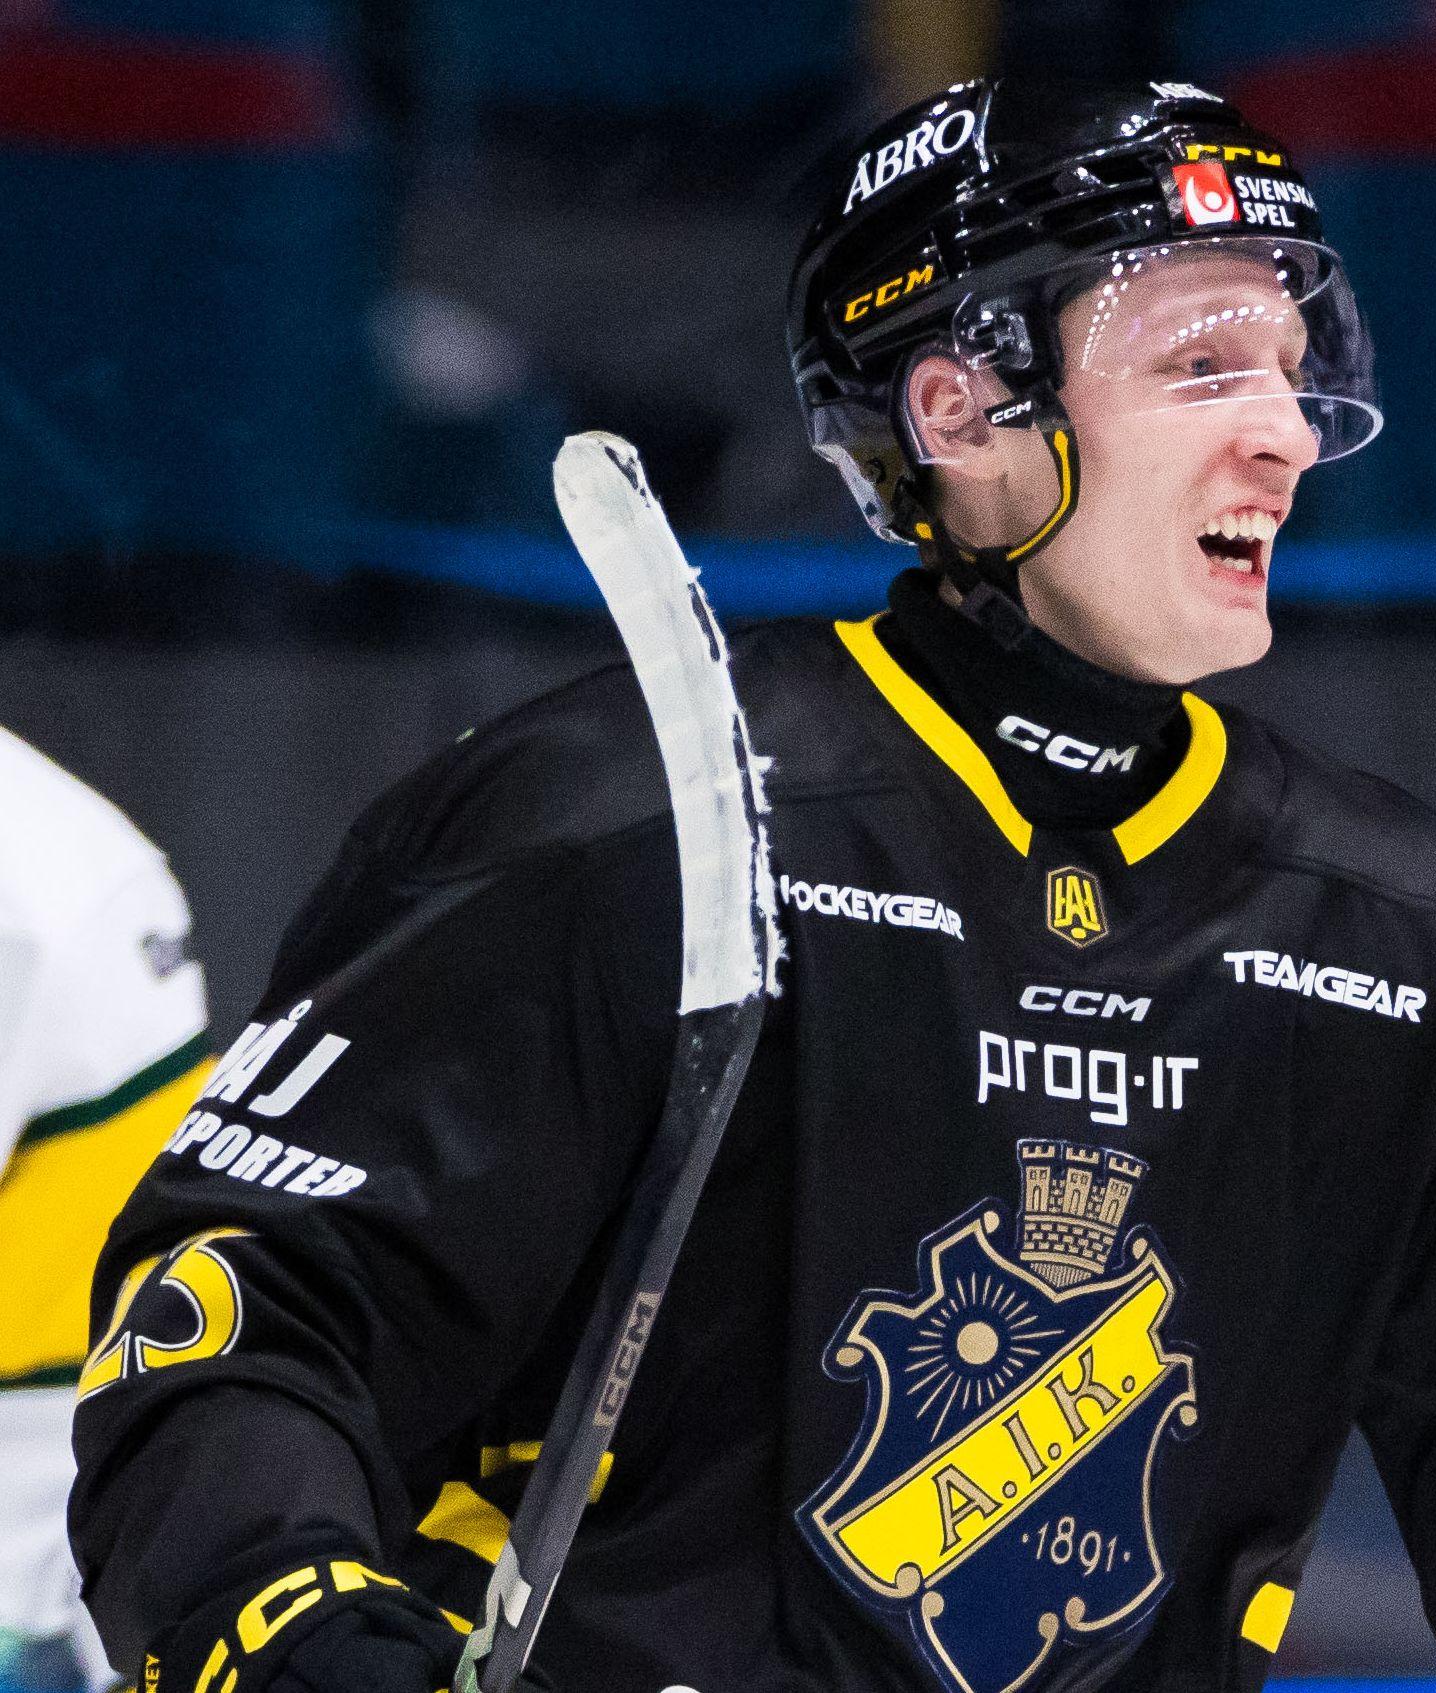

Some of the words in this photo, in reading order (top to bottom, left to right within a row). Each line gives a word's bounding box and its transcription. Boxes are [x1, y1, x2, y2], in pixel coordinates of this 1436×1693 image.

[1242, 201, 1296, 227] SPEL
[843, 264, 934, 322] CCM
[990, 400, 1032, 424] CCM
[996, 715, 1140, 773] CCM
[1018, 985, 1152, 1022] CCM
[1223, 950, 1427, 1023] TEAMGEAR
[599, 1299, 652, 1416] CCM
